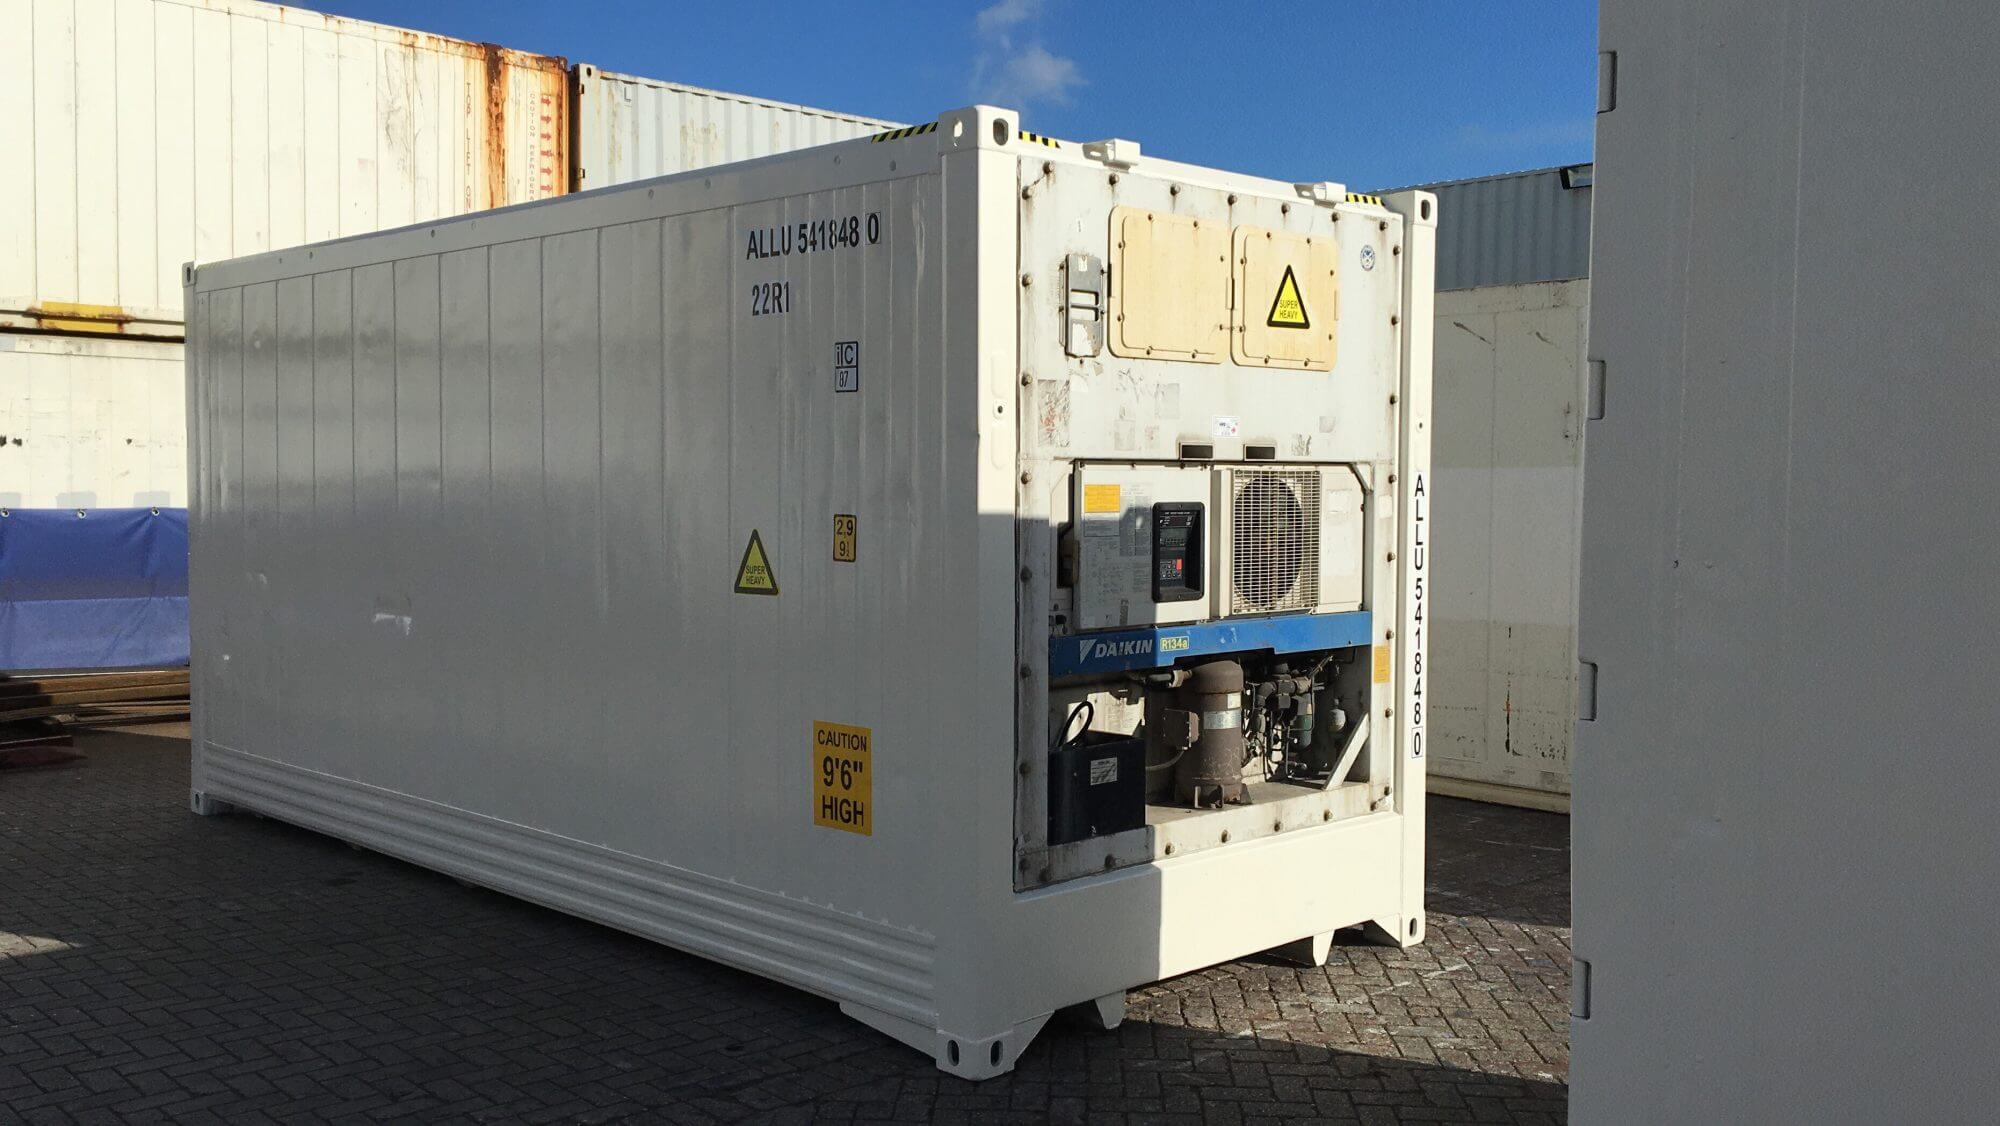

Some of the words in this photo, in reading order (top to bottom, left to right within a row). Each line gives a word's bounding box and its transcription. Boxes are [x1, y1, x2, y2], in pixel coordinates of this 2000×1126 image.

[746, 225, 792, 260] ALLU
[797, 215, 860, 254] 541848
[752, 281, 790, 316] 22R1
[1280, 299, 1299, 309] SUPER
[1280, 309, 1298, 319] HEAVY
[839, 370, 849, 388] 87
[1414, 473, 1424, 571] ALLU
[745, 565, 766, 575] SUPER
[745, 575, 766, 585] HEAVY
[1095, 640, 1153, 658] DAIKIN
[1162, 638, 1188, 650] R134a
[1413, 577, 1423, 725] 541848
[817, 729, 867, 753] CAUTION
[822, 755, 863, 791] 9'6"
[822, 794, 864, 827] HIGH
